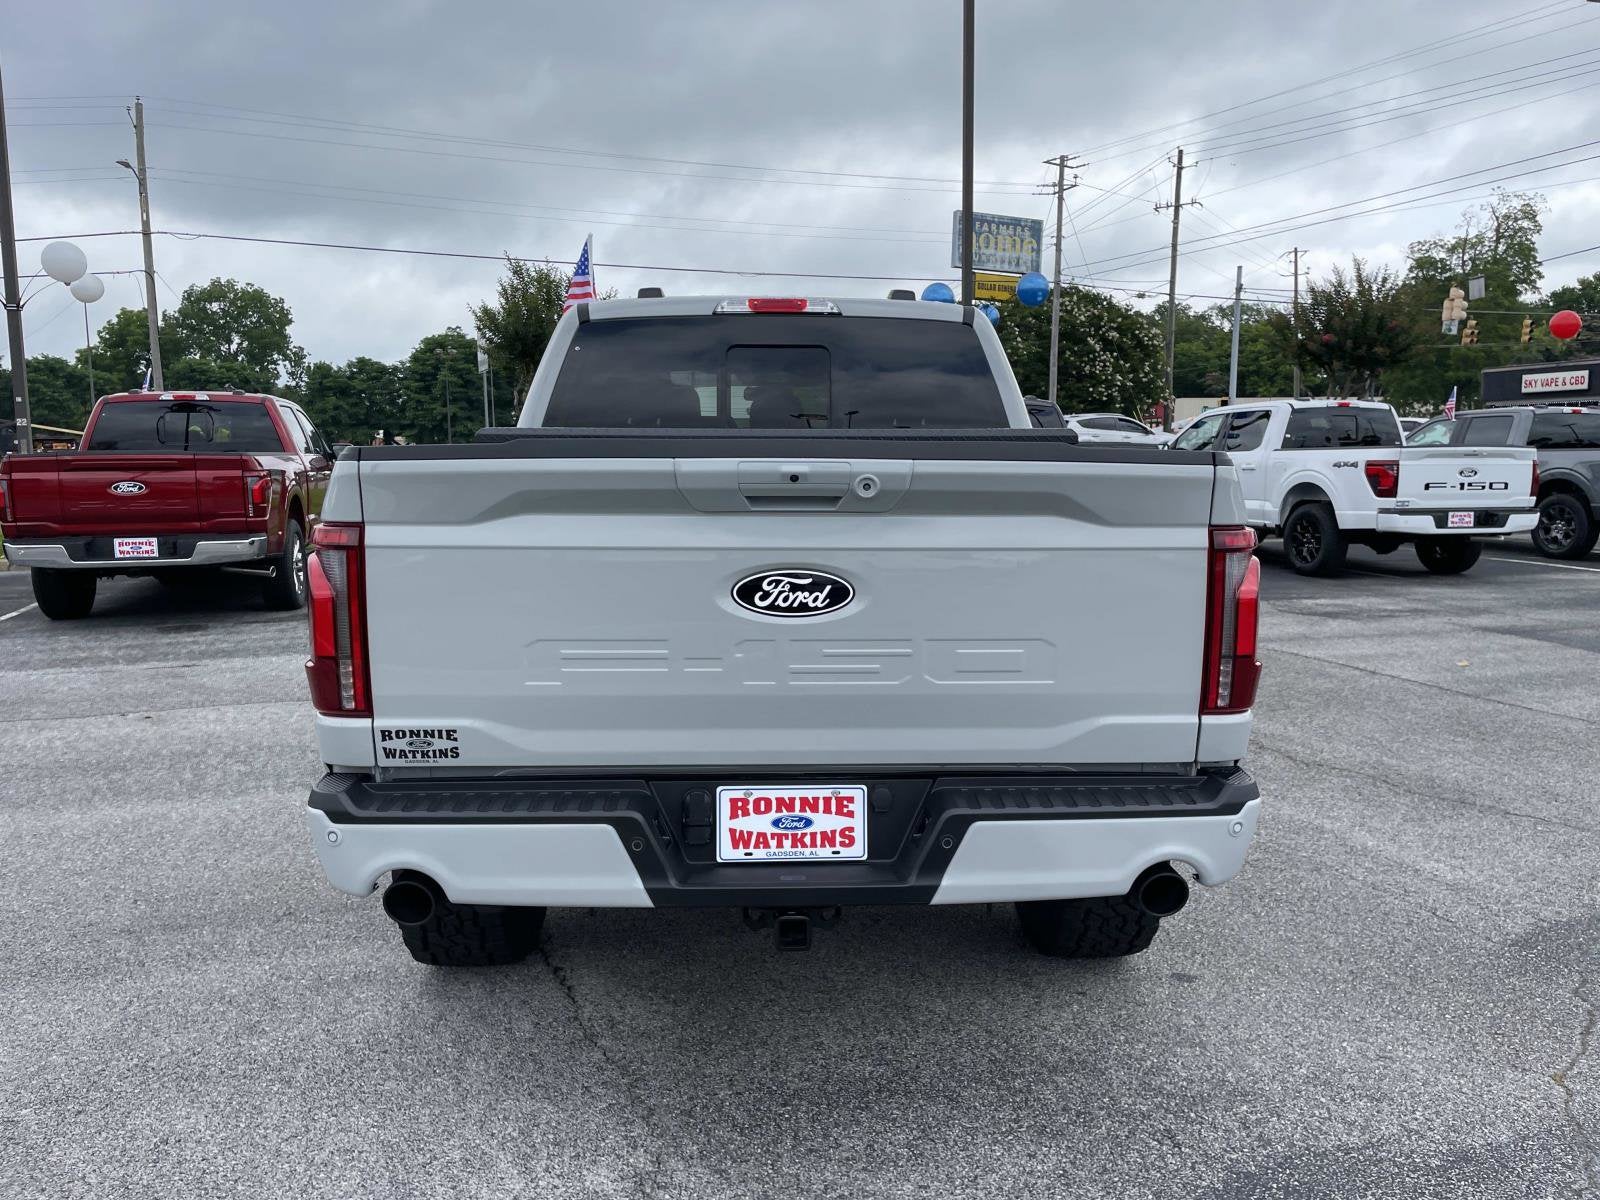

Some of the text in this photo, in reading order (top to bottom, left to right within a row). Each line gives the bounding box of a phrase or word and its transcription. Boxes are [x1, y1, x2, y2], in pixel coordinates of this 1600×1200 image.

[975, 221, 1031, 234] FARMERS
[1523, 375, 1586, 389] SKY VAPE & CBD
[16, 417, 28, 426] 22
[1424, 481, 1509, 491] F-150
[118, 540, 155, 548] RONNIE
[118, 548, 155, 556] WATKINS
[380, 729, 459, 743] RONNIE
[382, 746, 460, 760] WATKINS
[729, 796, 855, 820] RONNIE
[729, 826, 856, 850] WATKINS
[765, 850, 807, 858] GADSDEN,
